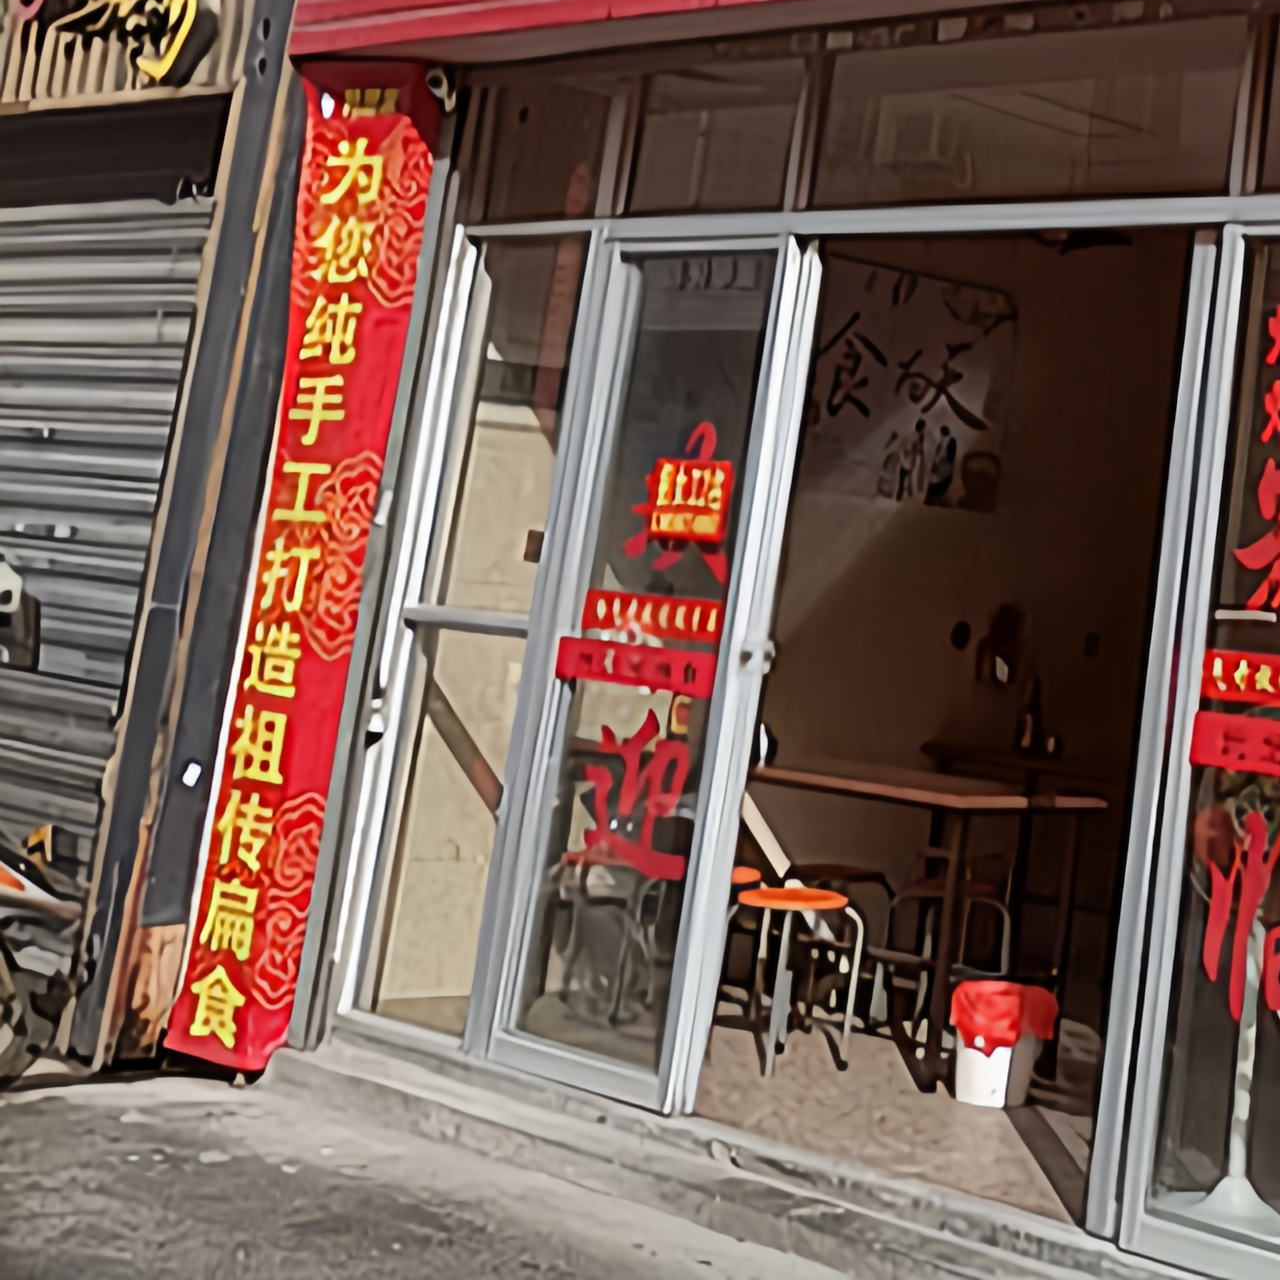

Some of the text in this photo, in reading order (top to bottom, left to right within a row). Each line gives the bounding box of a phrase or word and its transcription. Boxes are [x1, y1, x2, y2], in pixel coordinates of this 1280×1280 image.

[189, 137, 384, 1051] 为您纯手工打造祖传扁食
